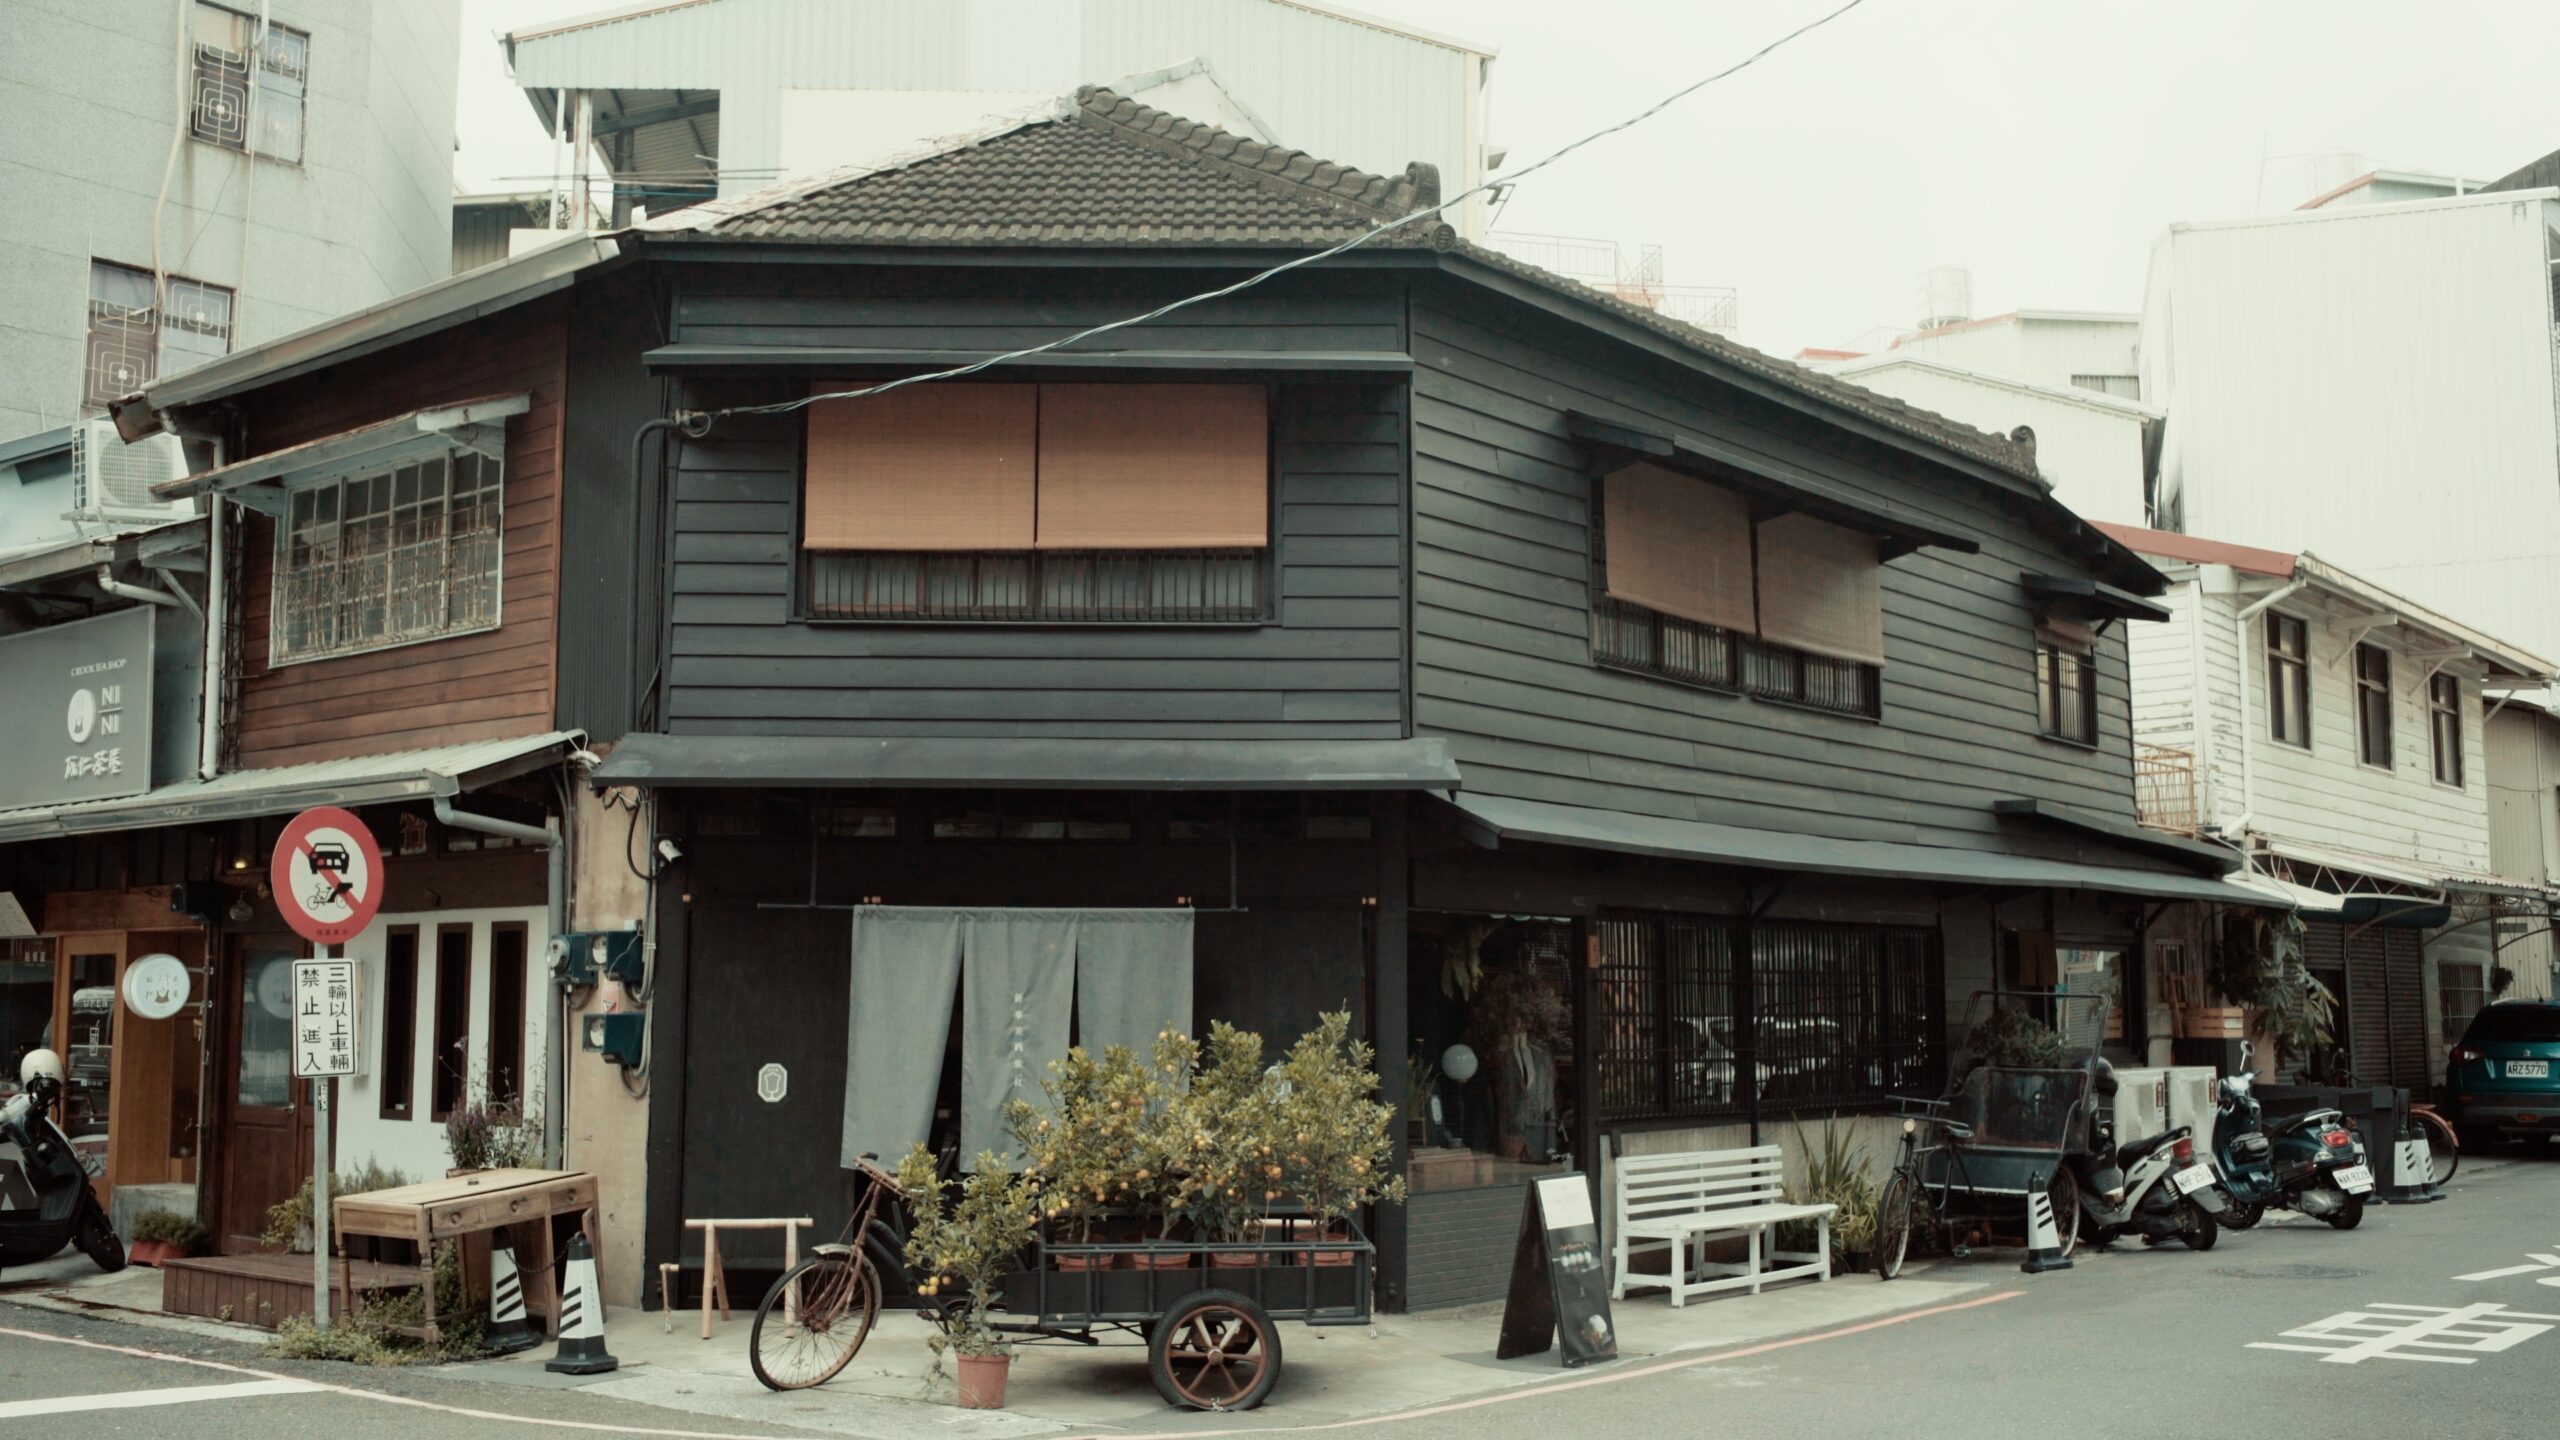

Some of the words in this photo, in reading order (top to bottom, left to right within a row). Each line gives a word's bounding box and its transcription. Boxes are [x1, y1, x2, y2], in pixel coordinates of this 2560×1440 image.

[102, 685, 120, 706] NI
[102, 714, 119, 736] NI
[301, 968, 321, 1072] 禁止進入
[328, 967, 349, 1071] 三輪以上車輛
